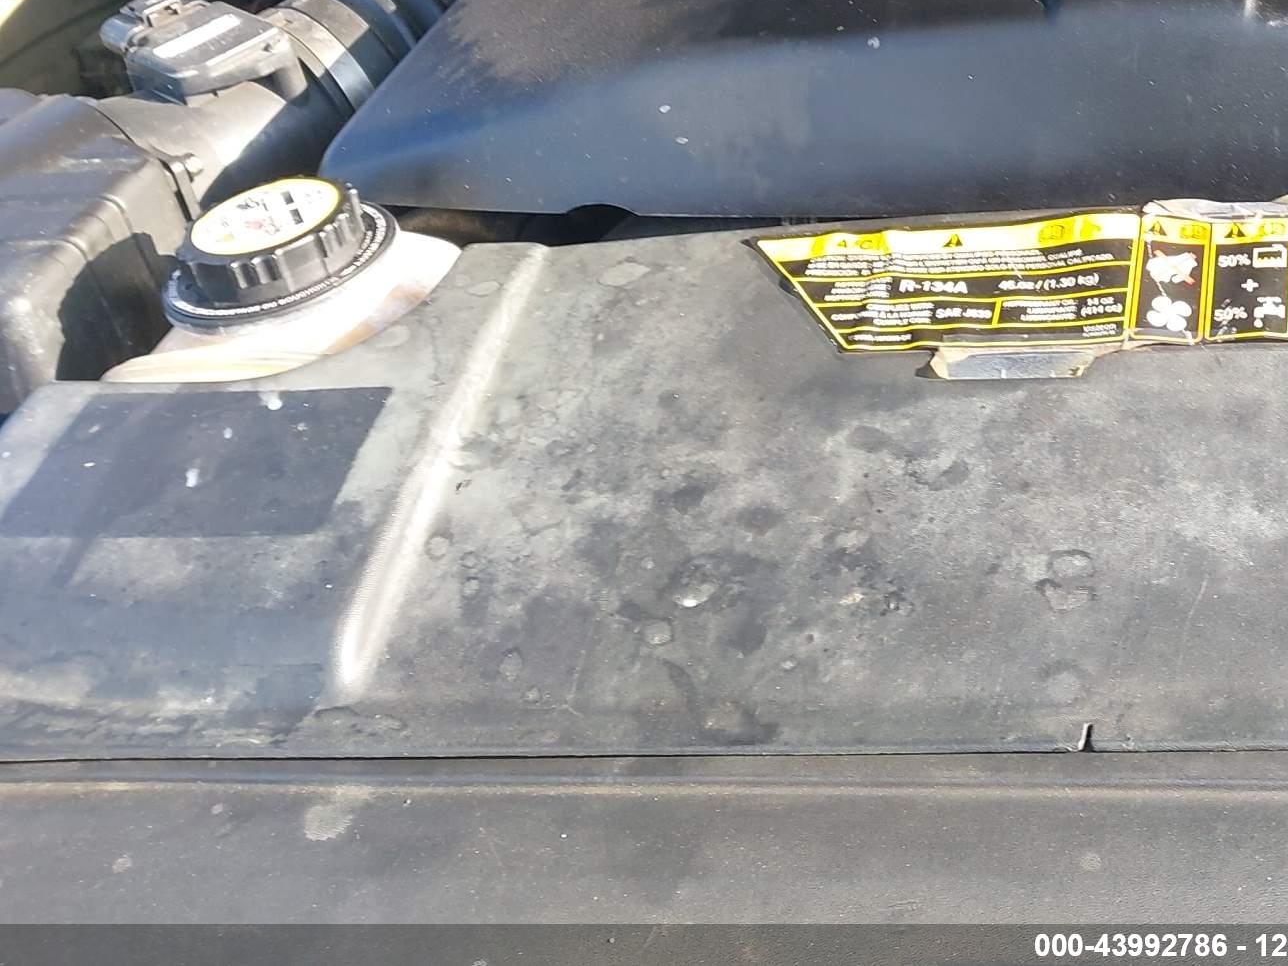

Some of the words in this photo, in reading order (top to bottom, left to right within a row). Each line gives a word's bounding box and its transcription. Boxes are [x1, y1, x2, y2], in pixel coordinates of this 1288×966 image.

[1217, 253, 1252, 268] 50%
[898, 278, 969, 293] R-134A
[1213, 306, 1248, 322] 50%
